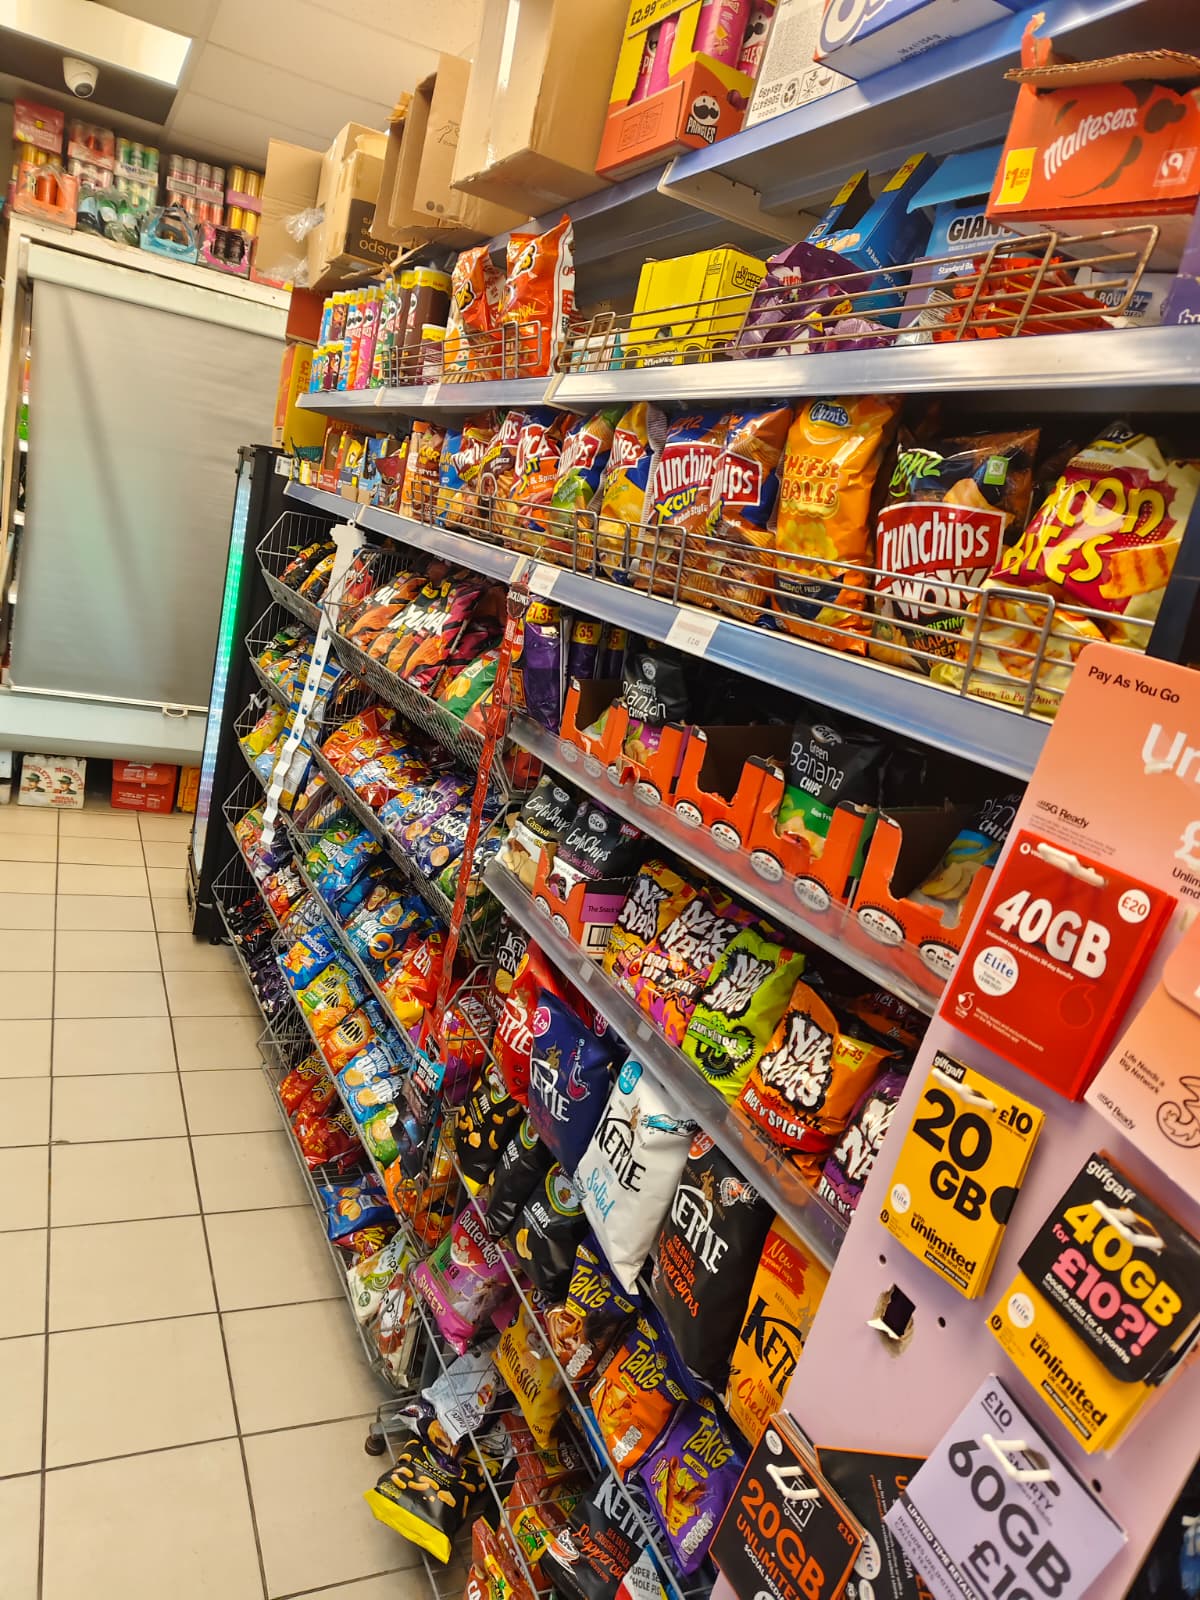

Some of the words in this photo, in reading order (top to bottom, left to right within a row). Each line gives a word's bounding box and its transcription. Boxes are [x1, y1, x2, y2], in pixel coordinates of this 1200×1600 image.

[630, 2, 657, 27] £2.99
[685, 115, 717, 144] PRINGLES
[1043, 107, 1138, 181] Maltesers
[949, 214, 1012, 242] GIAN
[1098, 290, 1145, 310] BOUTY
[655, 447, 716, 498] runchip
[781, 479, 839, 506] BALLS
[1088, 666, 1112, 685] Pay
[1113, 675, 1131, 689] As
[1134, 680, 1158, 697] You
[1160, 688, 1181, 704] Go
[790, 742, 845, 792] Banana
[809, 740, 829, 762] Green
[800, 777, 822, 797] CHIPS
[526, 816, 550, 837] Casava
[621, 824, 638, 838] New
[1059, 808, 1090, 829] Ready
[1121, 897, 1148, 917] £20
[993, 890, 1111, 979] 40GB
[984, 951, 1015, 980] Elite
[533, 1009, 549, 1032] £1.29
[788, 1016, 834, 1070] NIK
[933, 1053, 966, 1081] giffgaff
[1119, 1058, 1134, 1073] Big
[1132, 1068, 1160, 1095] Network
[1123, 1050, 1139, 1064] Life
[1138, 1060, 1161, 1084] Needs
[767, 1108, 806, 1141] SPICY
[913, 1088, 993, 1172] 20
[998, 1104, 1034, 1135] £10
[1113, 1104, 1137, 1130] Ready
[587, 1167, 616, 1224] Salted
[929, 1160, 988, 1222] GB
[1086, 1160, 1137, 1204] giffgaff
[532, 1201, 551, 1230] CRISPS
[1052, 1223, 1070, 1244] for
[459, 1210, 501, 1269] Butterkist
[767, 1239, 794, 1270] New
[911, 1215, 977, 1276] unlimited
[660, 1231, 700, 1319] ppercorns
[1063, 1201, 1183, 1328] 40GB
[417, 1274, 447, 1317] SWEET
[570, 1264, 611, 1309] Takis
[1051, 1247, 1159, 1358] £10?!
[1011, 1299, 1030, 1323] Elite
[1041, 1272, 1073, 1300] Double
[1065, 1297, 1089, 1318] data
[1083, 1313, 1100, 1329] for
[1097, 1332, 1135, 1365] months
[740, 1295, 804, 1396] KETT
[1034, 1332, 1051, 1351] with
[501, 1334, 518, 1369] SWEET
[516, 1367, 542, 1404] SALTY
[620, 1339, 665, 1388] Takis
[1030, 1336, 1108, 1428] unlimited
[737, 1378, 769, 1427] Ched
[984, 1391, 1014, 1429] £10
[683, 1416, 734, 1469] Takis
[1008, 1451, 1055, 1511] SMRTY
[838, 1521, 855, 1546] £10
[906, 1503, 934, 1543] LIMITED
[932, 1538, 951, 1567] TIME
[948, 1439, 1072, 1600] 60GB
[573, 1523, 627, 1582] Peppercor
[741, 1479, 825, 1600] 20GB
[632, 1566, 651, 1580] UPER
[743, 1544, 766, 1578] SOCIAL
[632, 1579, 650, 1594] HOLE
